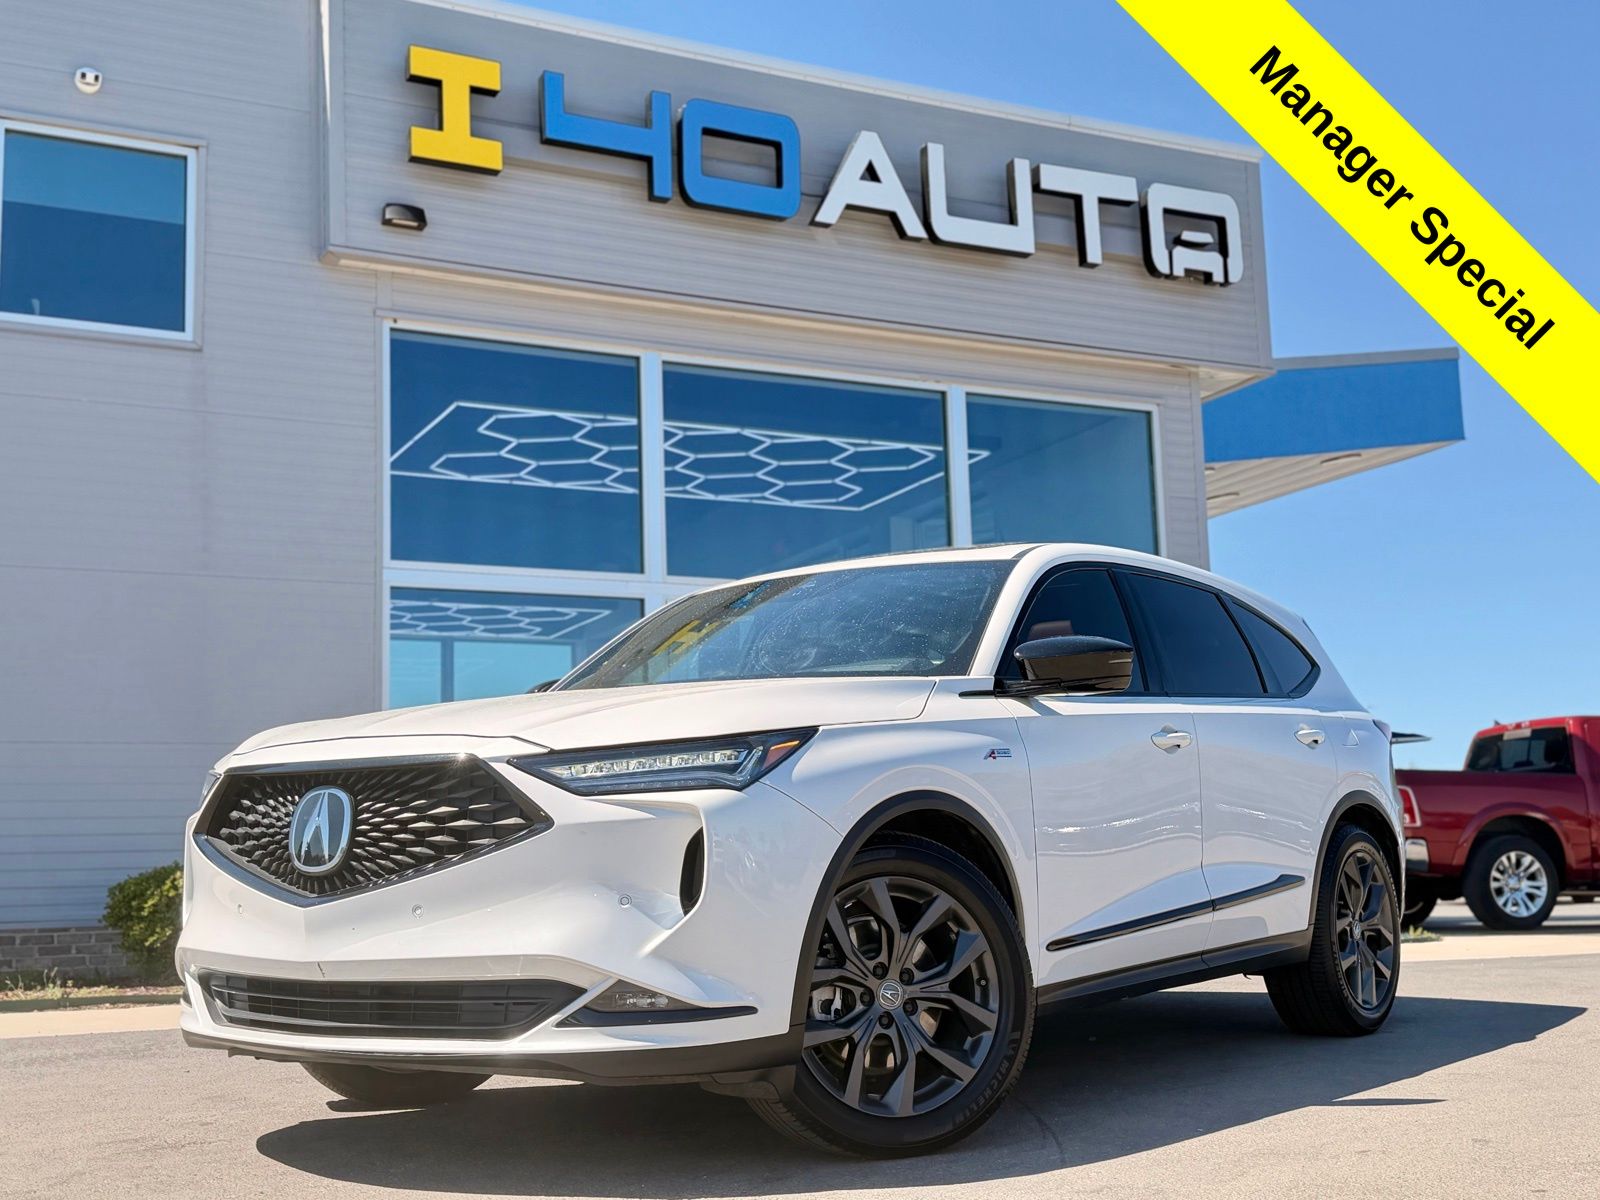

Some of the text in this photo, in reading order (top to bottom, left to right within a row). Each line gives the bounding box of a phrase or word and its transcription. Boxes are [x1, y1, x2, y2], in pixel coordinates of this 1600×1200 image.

[408, 45, 1244, 285] I 40 AUTO
